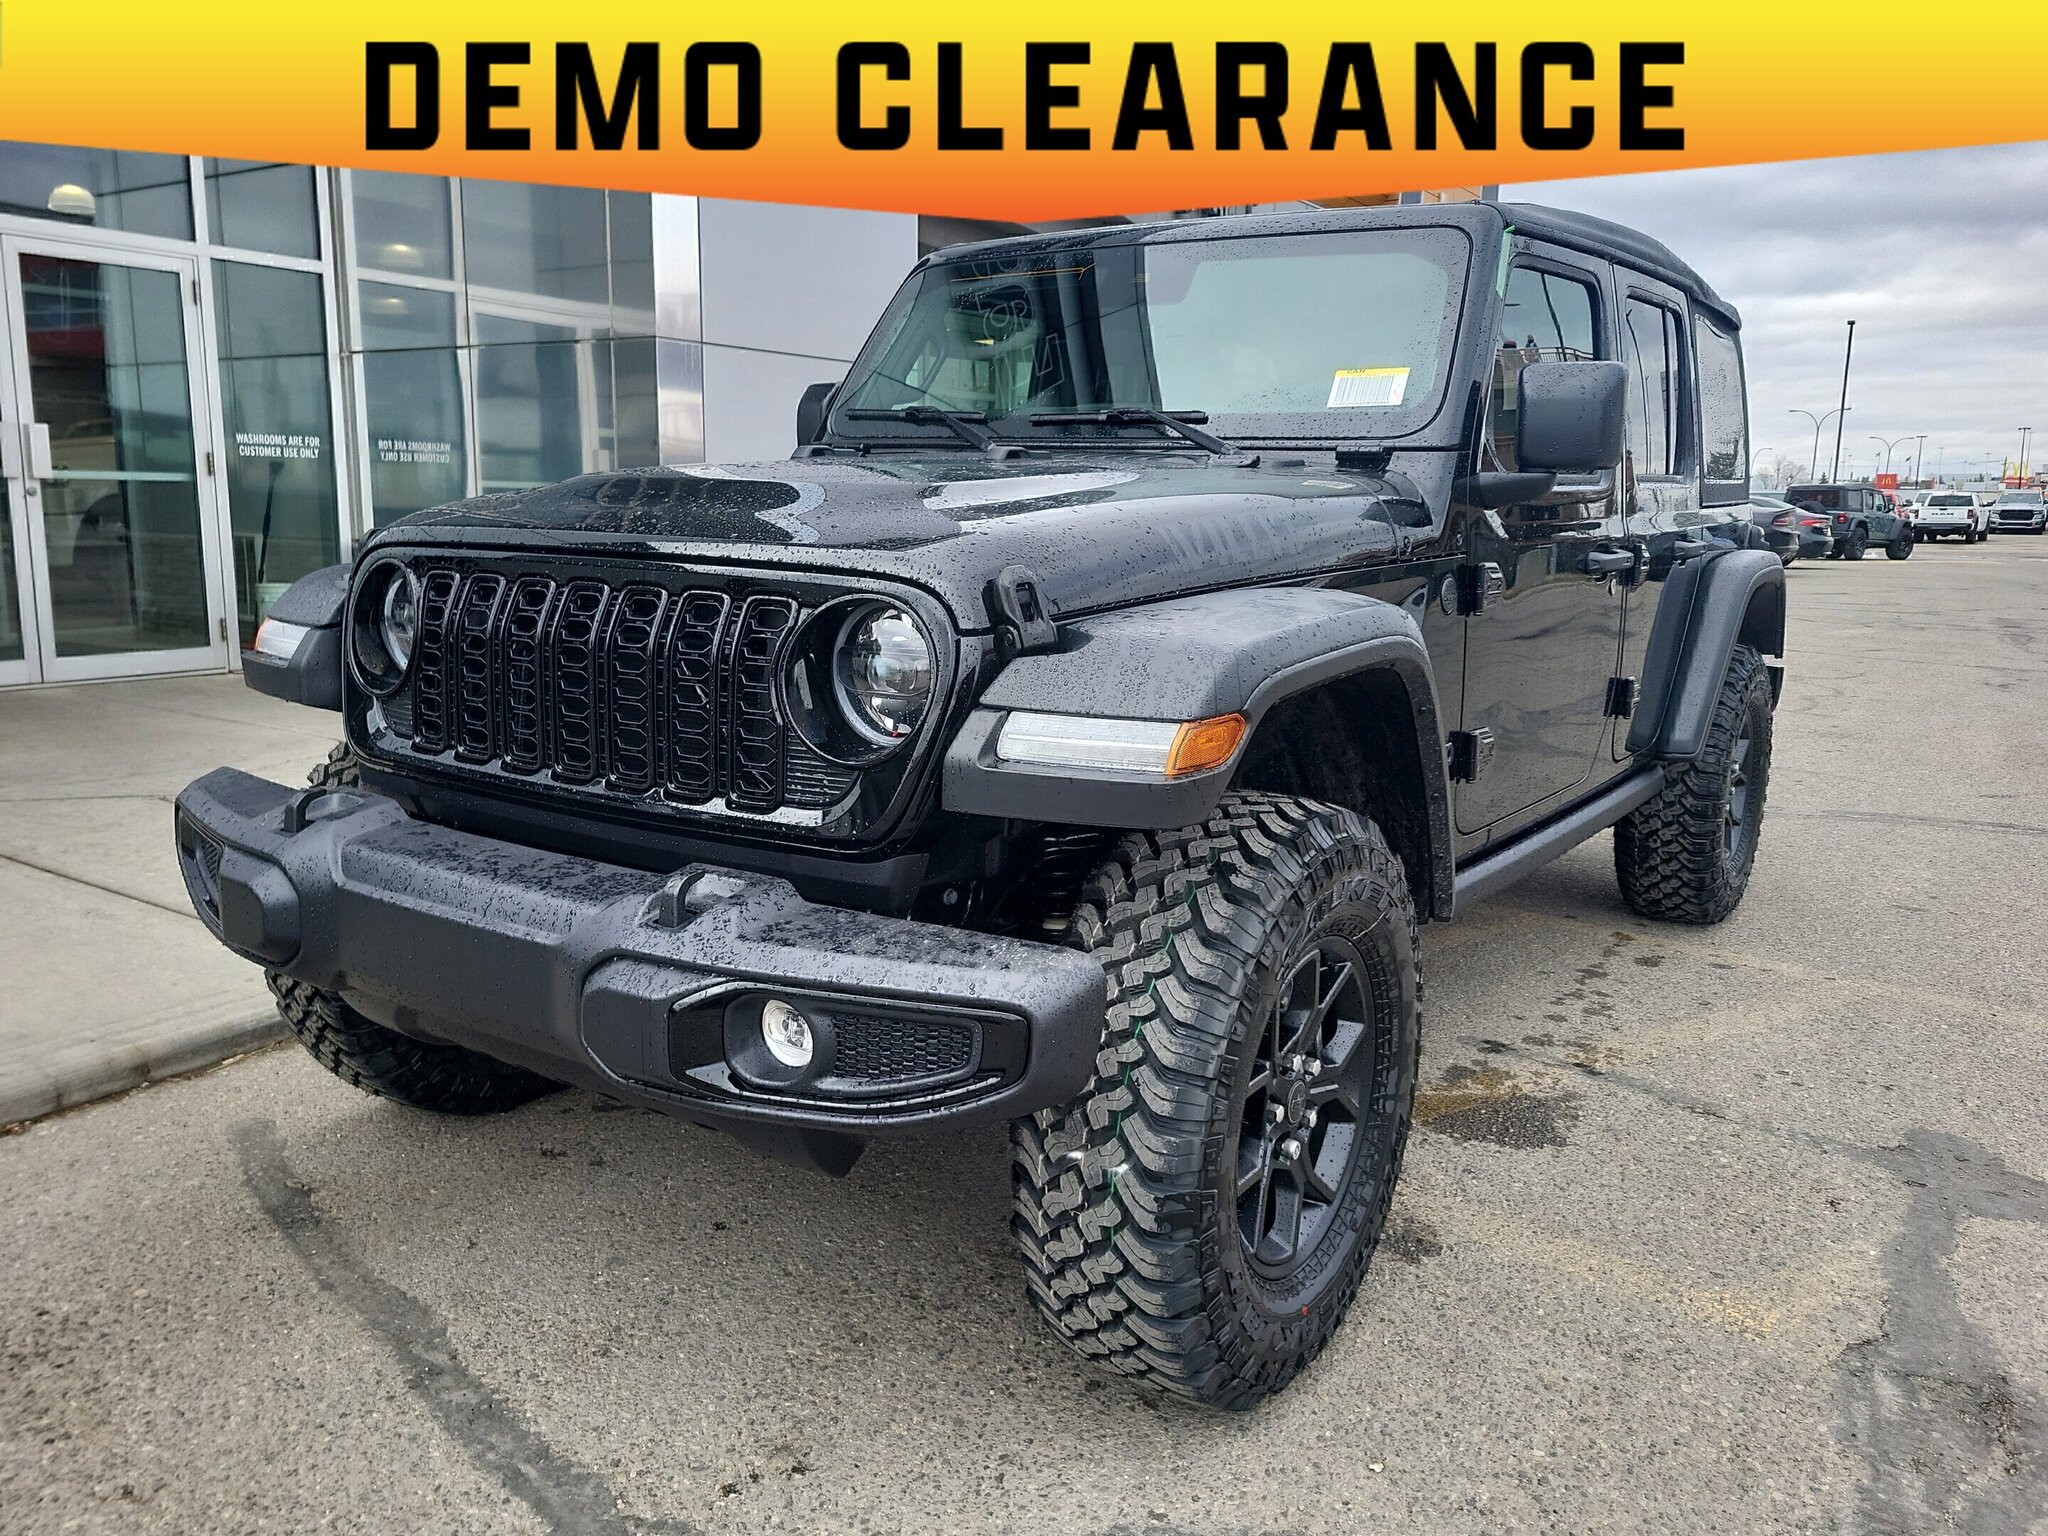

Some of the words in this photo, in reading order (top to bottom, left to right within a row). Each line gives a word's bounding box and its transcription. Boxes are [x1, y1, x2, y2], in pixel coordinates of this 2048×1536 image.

[235, 432, 287, 446] WASHROOMS
[288, 435, 303, 447] ARE
[304, 436, 320, 447] FOR
[239, 444, 282, 458] CUSTOMER
[283, 446, 299, 458] USE
[299, 447, 319, 459] ONLY
